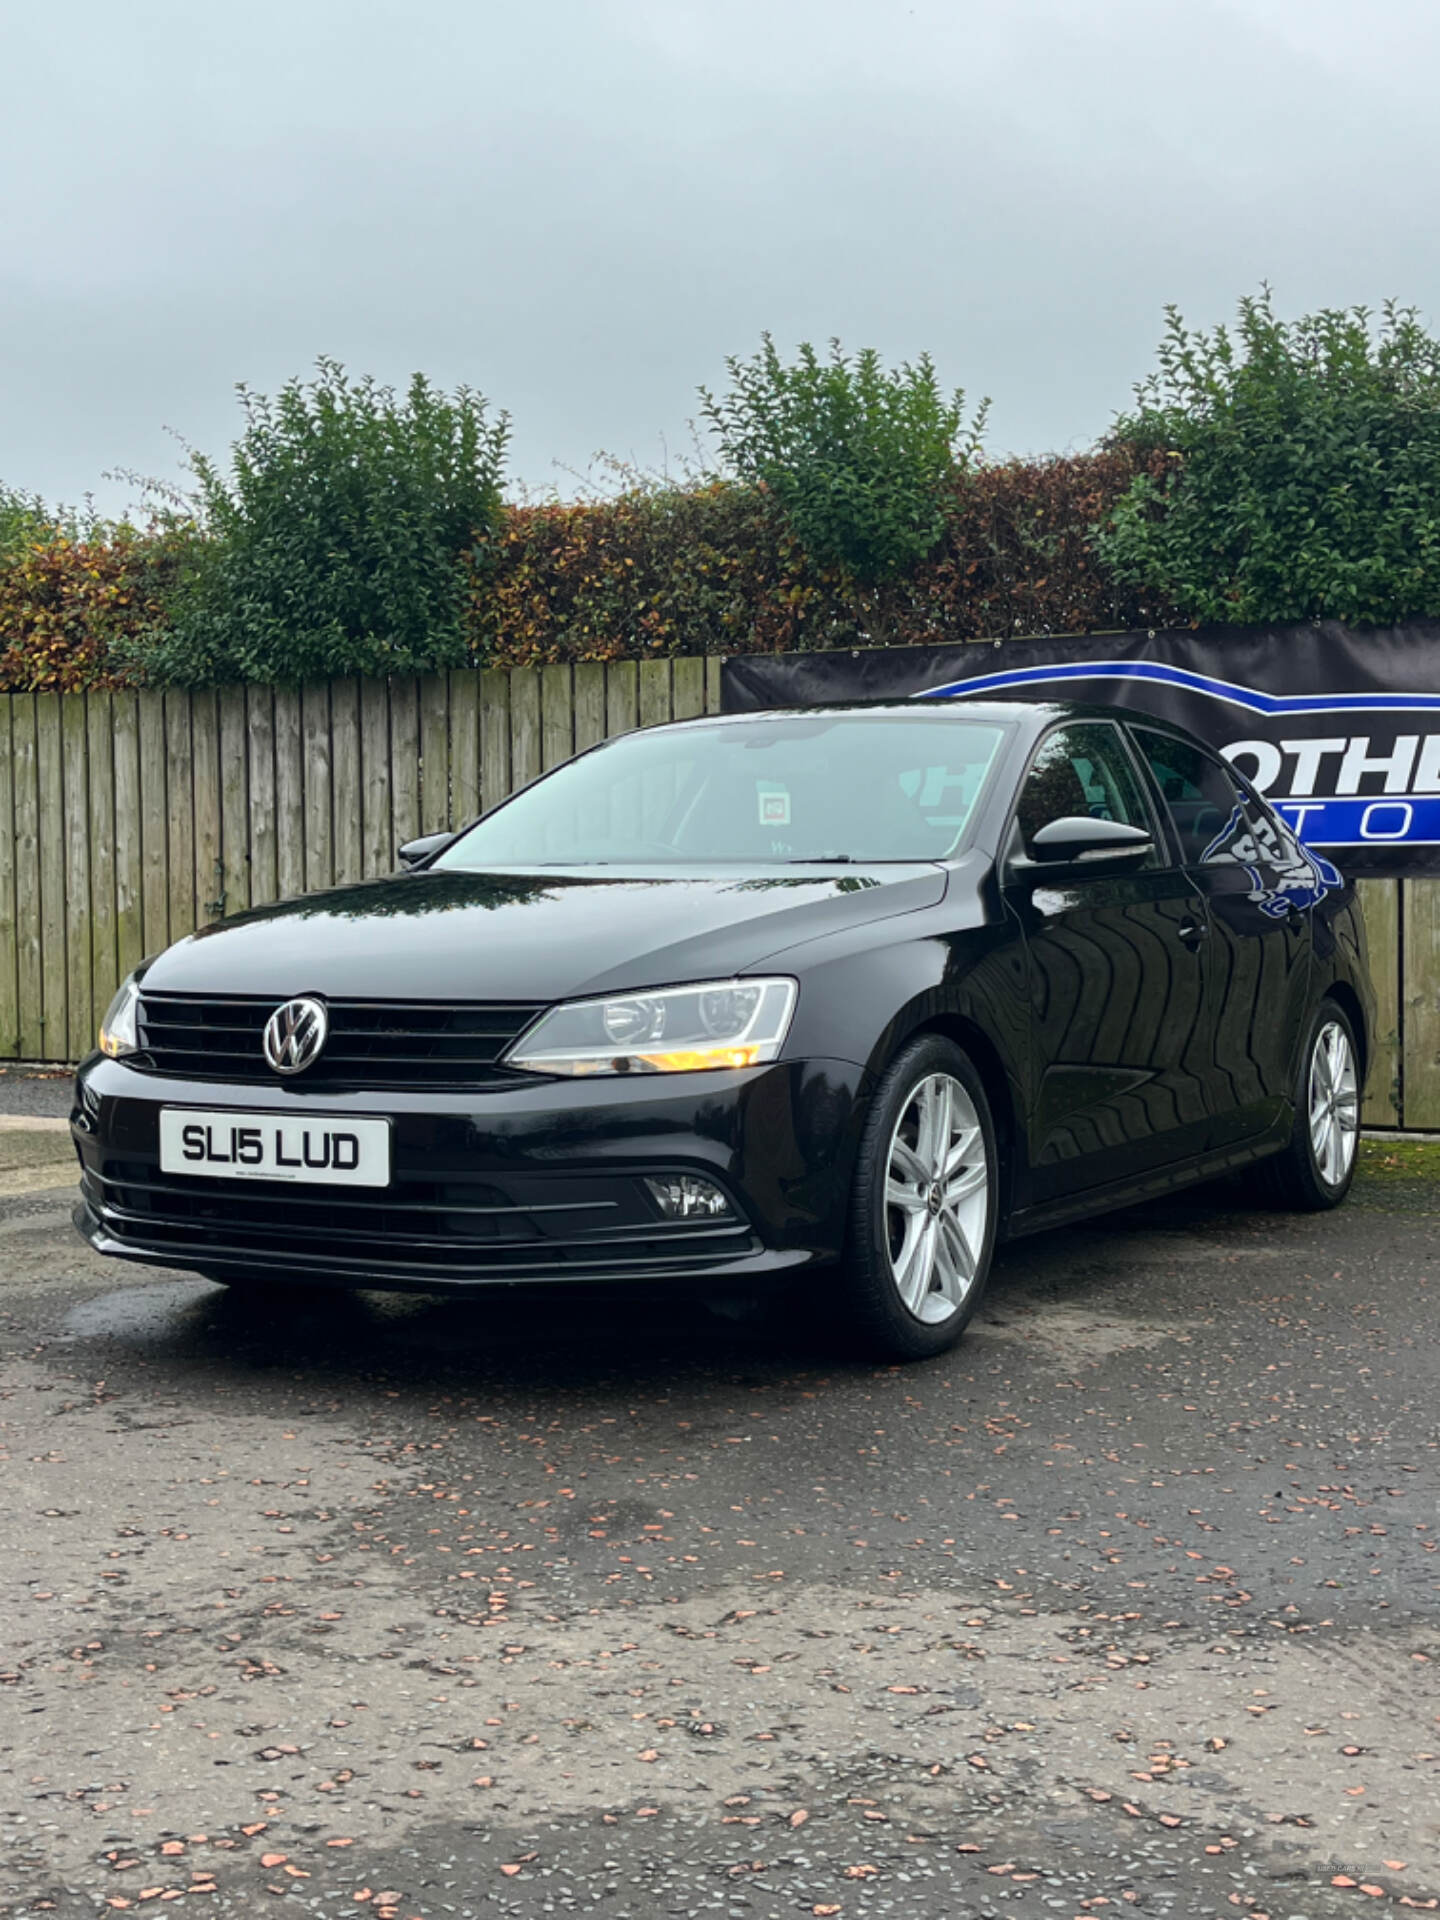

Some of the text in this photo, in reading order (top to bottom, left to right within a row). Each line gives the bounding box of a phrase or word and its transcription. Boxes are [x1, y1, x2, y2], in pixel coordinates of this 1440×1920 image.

[264, 998, 326, 1075] VW
[182, 1125, 359, 1170] SL15 LUD
